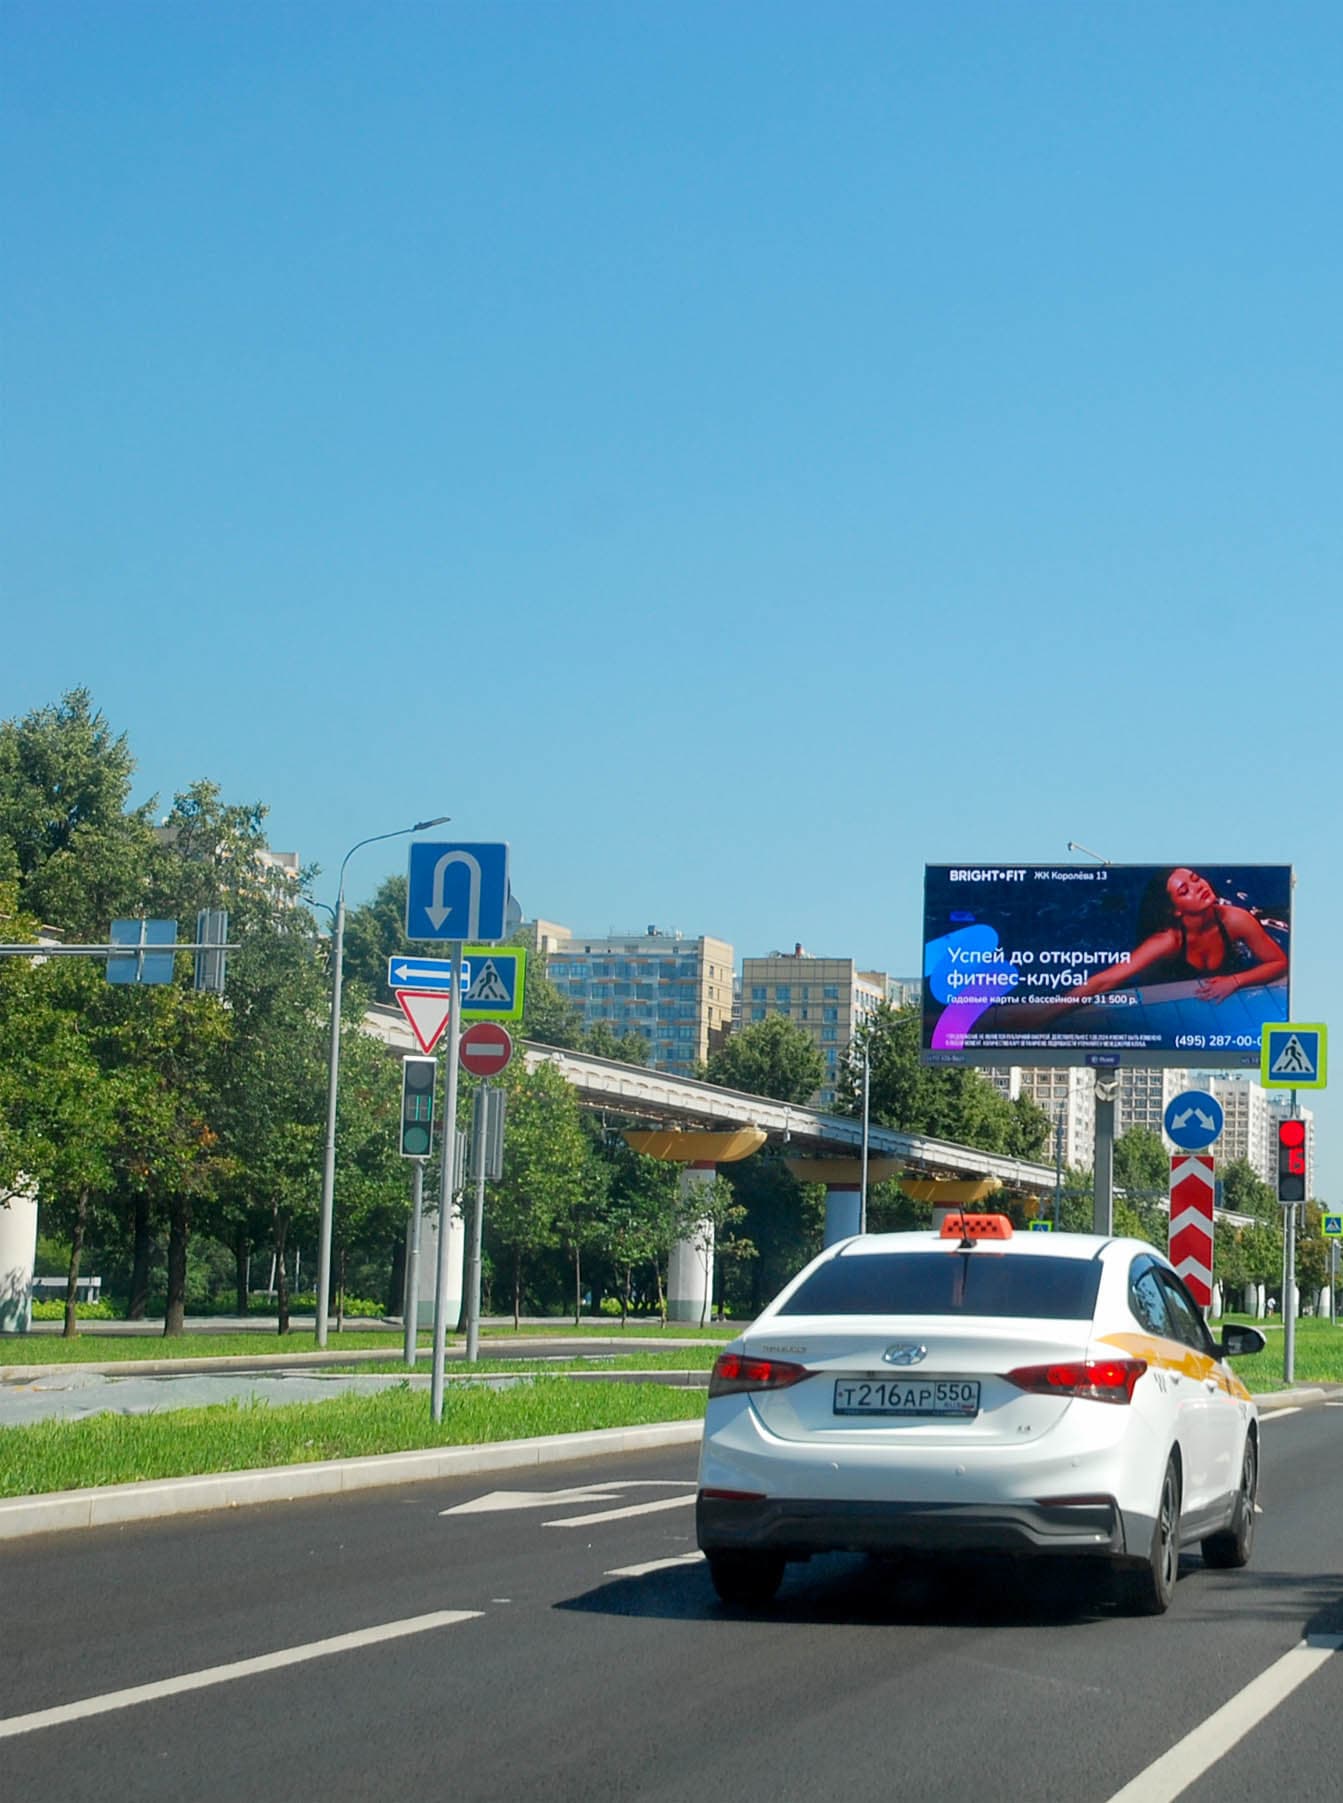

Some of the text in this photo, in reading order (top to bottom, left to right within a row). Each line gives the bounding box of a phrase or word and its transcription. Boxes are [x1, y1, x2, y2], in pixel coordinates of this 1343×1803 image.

[1034, 871, 1108, 882] ЖК Королёва 13
[947, 947, 1132, 967] Успей до открытия
[947, 969, 1089, 989] фитнес-клуба!
[946, 993, 1138, 1006] Годовые карты с бассейном от 31 500 р.
[1175, 1034, 1206, 1049] (495)
[1288, 1147, 1306, 1175] 6
[843, 1383, 973, 1407] Т216АР 550
